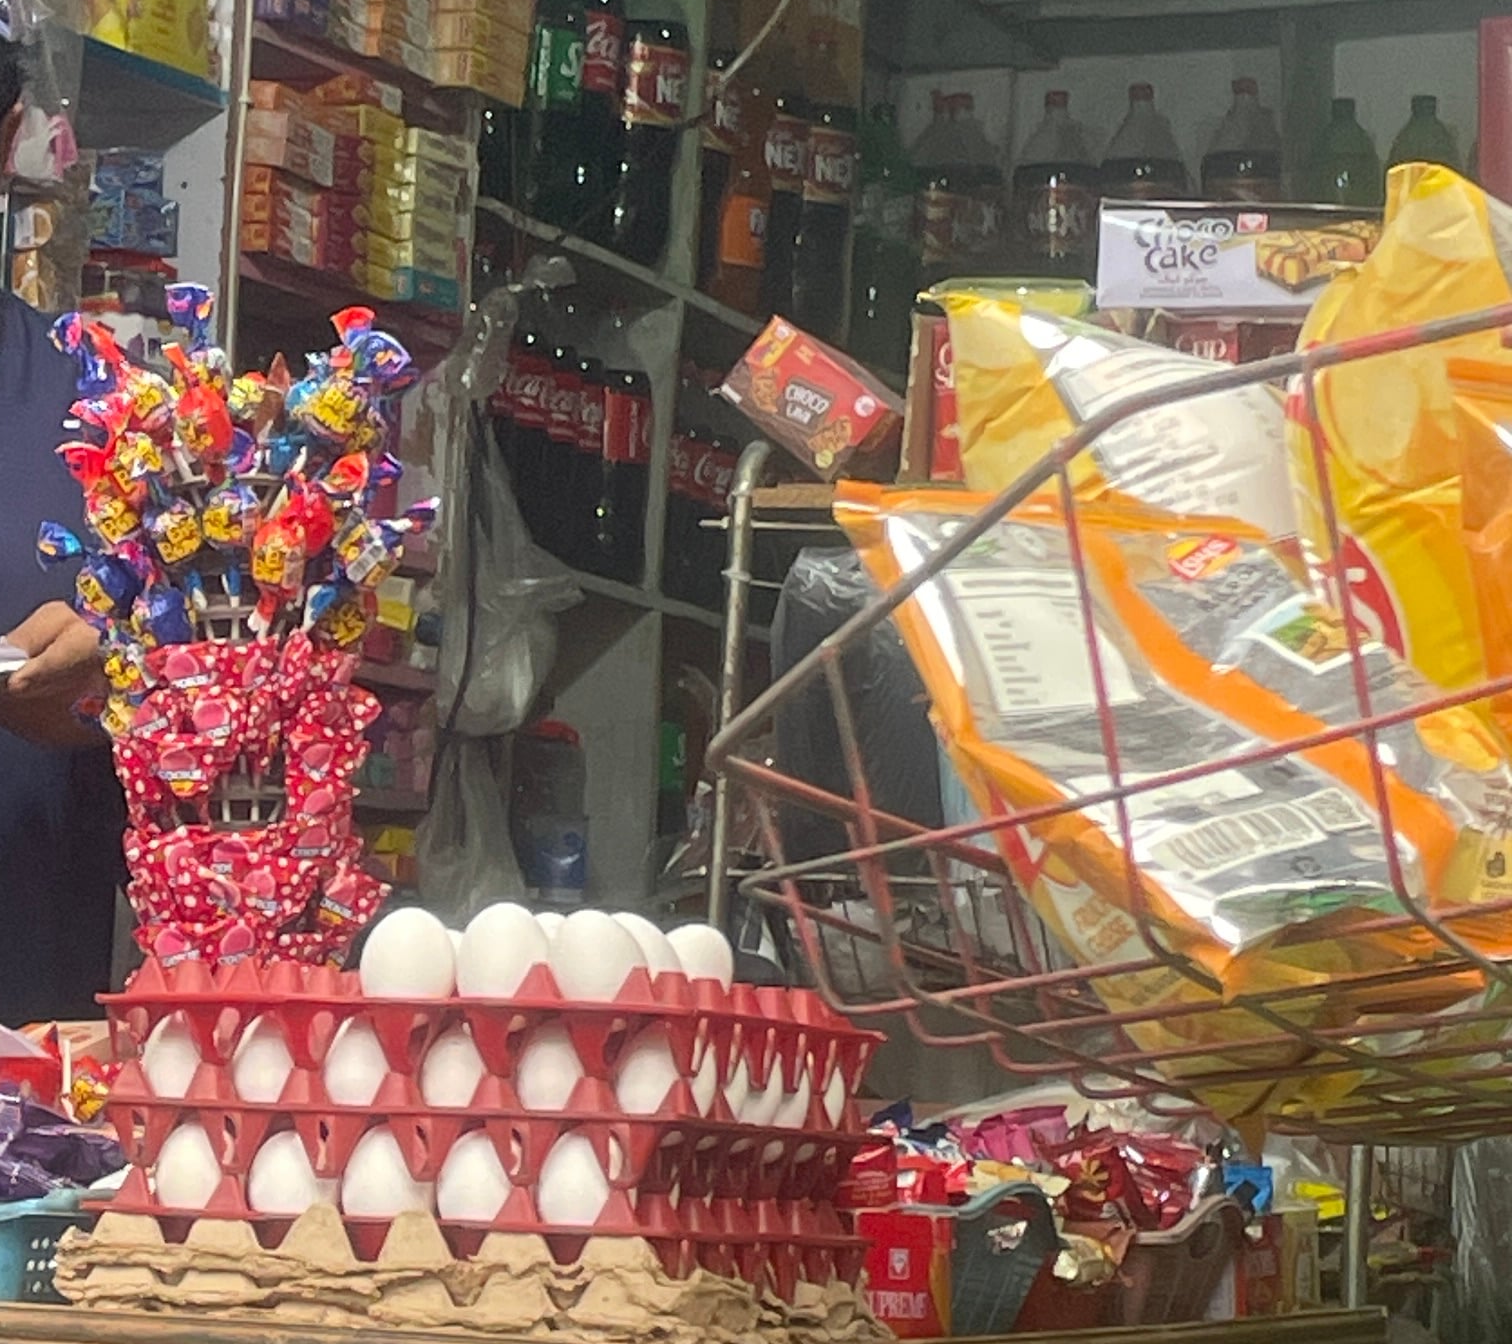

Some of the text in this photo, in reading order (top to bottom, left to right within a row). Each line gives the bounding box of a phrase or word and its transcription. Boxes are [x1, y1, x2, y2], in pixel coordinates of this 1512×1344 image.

[1134, 217, 1235, 249] Choco
[784, 383, 830, 415] CHOCO
[864, 1292, 928, 1319] UPREME
